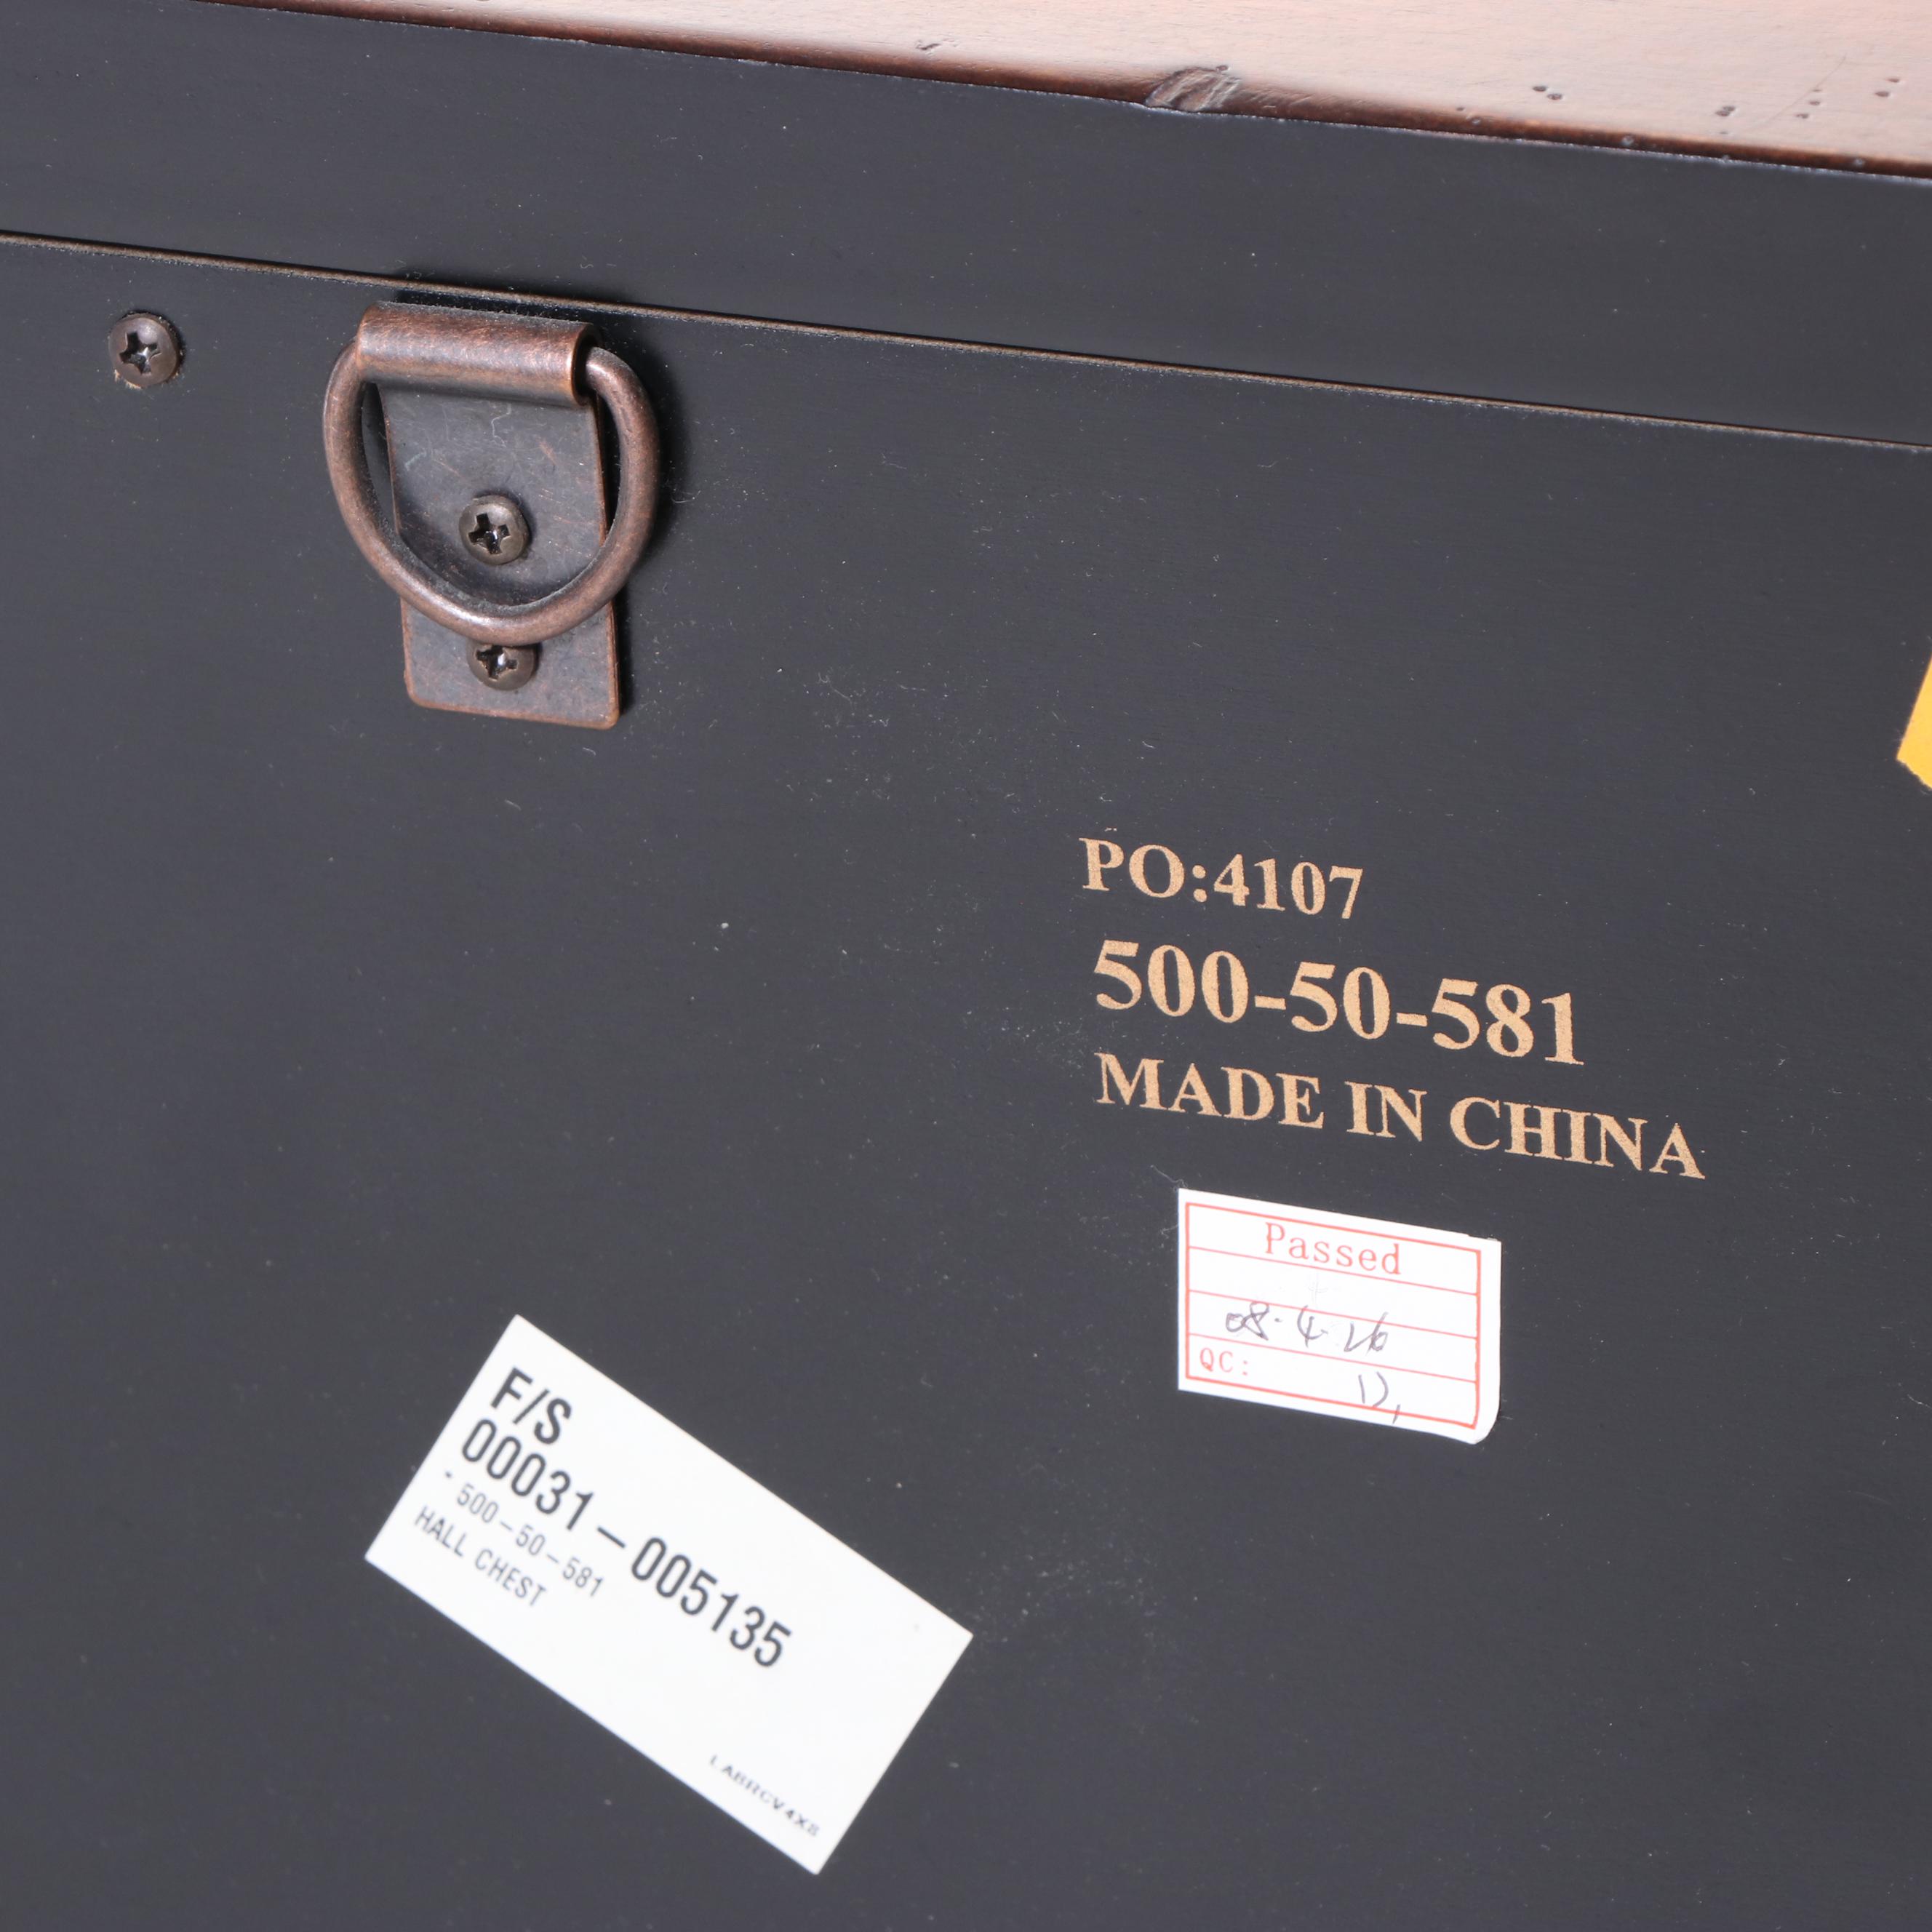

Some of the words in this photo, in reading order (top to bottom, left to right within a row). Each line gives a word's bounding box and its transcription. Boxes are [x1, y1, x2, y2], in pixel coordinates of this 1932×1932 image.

[1079, 838, 1364, 919] PO:4107
[1093, 940, 1584, 1067] 500-50-581
[1094, 1052, 1325, 1130] MADE
[1344, 1081, 1428, 1143] IN
[1449, 1097, 1707, 1180] CHINA
[1264, 1222, 1402, 1275] Passed
[1199, 1346, 1249, 1377] QC:
[490, 1366, 573, 1445] F/S
[413, 1505, 468, 1557] HALL
[474, 1547, 548, 1607] CHEST
